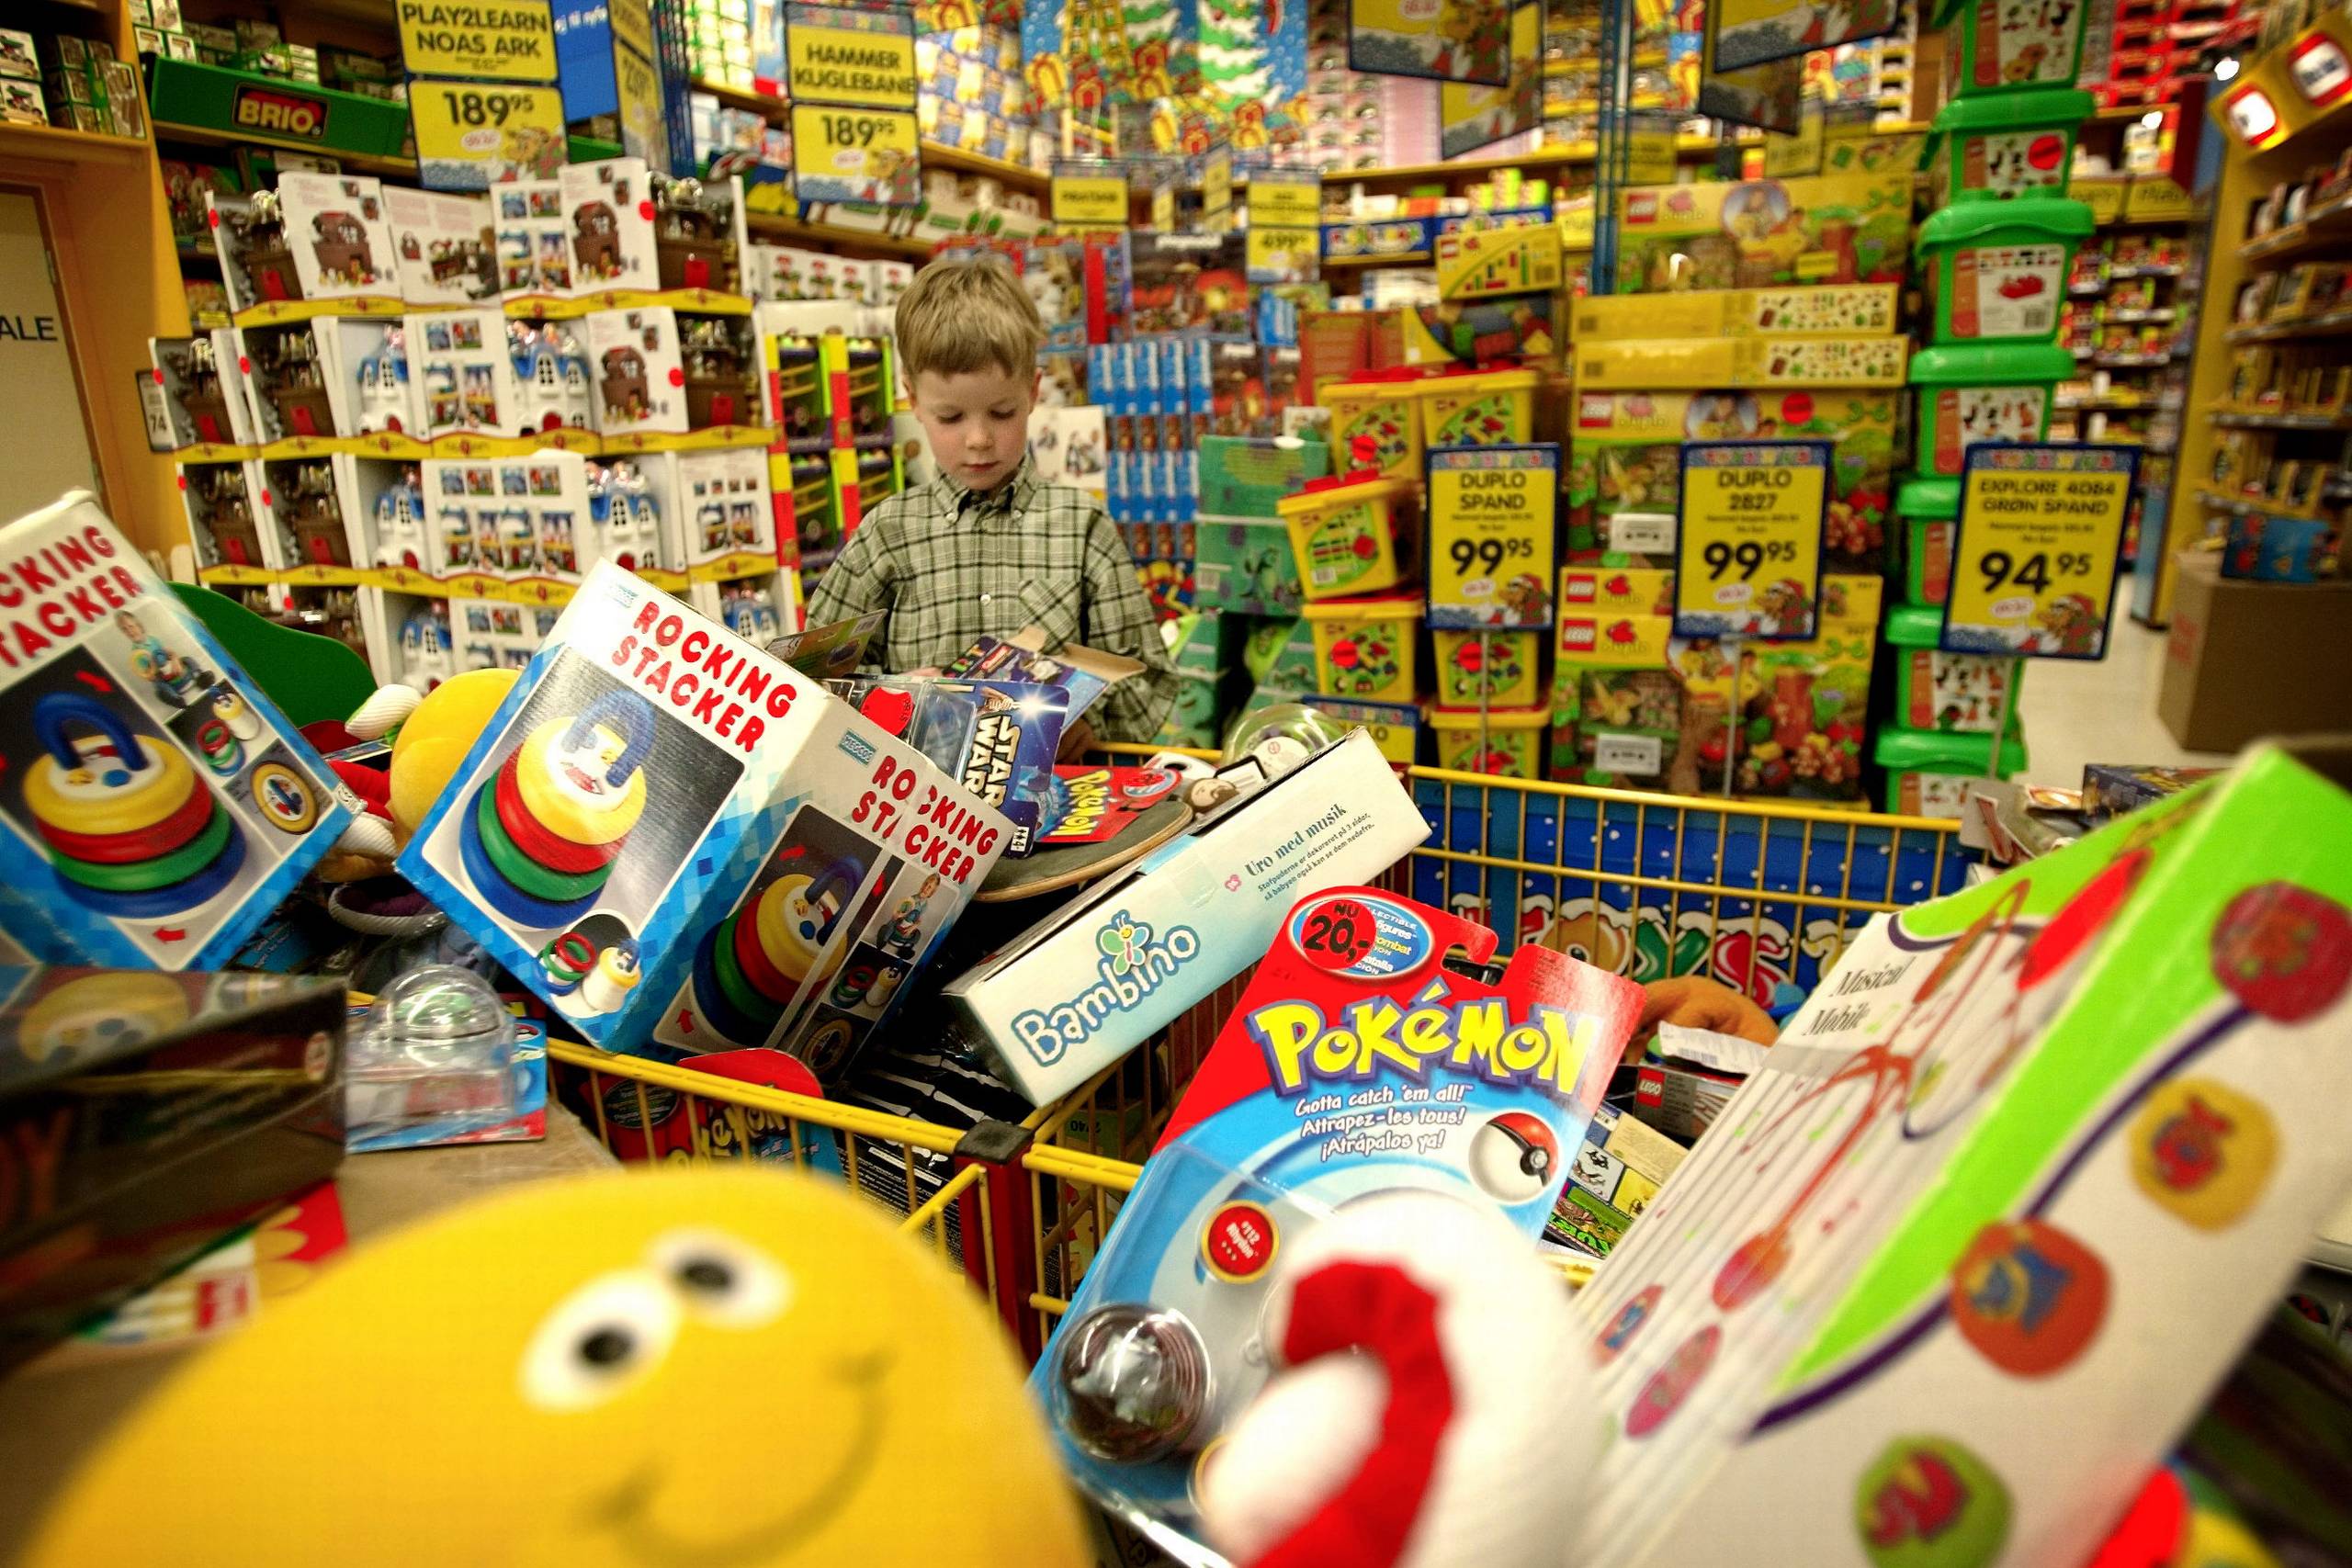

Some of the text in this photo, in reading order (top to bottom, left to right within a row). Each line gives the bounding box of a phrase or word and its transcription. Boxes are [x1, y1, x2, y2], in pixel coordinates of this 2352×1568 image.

[401, 3, 548, 33] PLAY2LEARN
[416, 30, 541, 58] NOAS ARK
[807, 43, 900, 69] HAMMER
[238, 96, 315, 134] BRIO
[0, 316, 58, 342] ALE
[1460, 472, 1526, 489] DUPLO
[1717, 469, 1792, 489] DUPLO
[1979, 479, 2059, 493] EXPLORE
[1460, 493, 1526, 511] SPAND
[2042, 498, 2109, 516] SPAND
[634, 602, 797, 718] ROCKING
[612, 635, 765, 753] STACKER
[984, 716, 1022, 808] STAR
[1244, 803, 1347, 876] Uro med musik
[1333, 903, 1360, 919] NU
[1828, 955, 1917, 998] Musical
[1011, 924, 1201, 1067] Bambino
[1799, 1002, 1871, 1036] Mobile
[1638, 1078, 1662, 1096] LEGO
[1295, 1097, 1342, 1118] Gotta
[1348, 1086, 1395, 1107] catch
[1418, 1106, 1466, 1125] tous!
[1418, 1130, 1447, 1155] ya!
